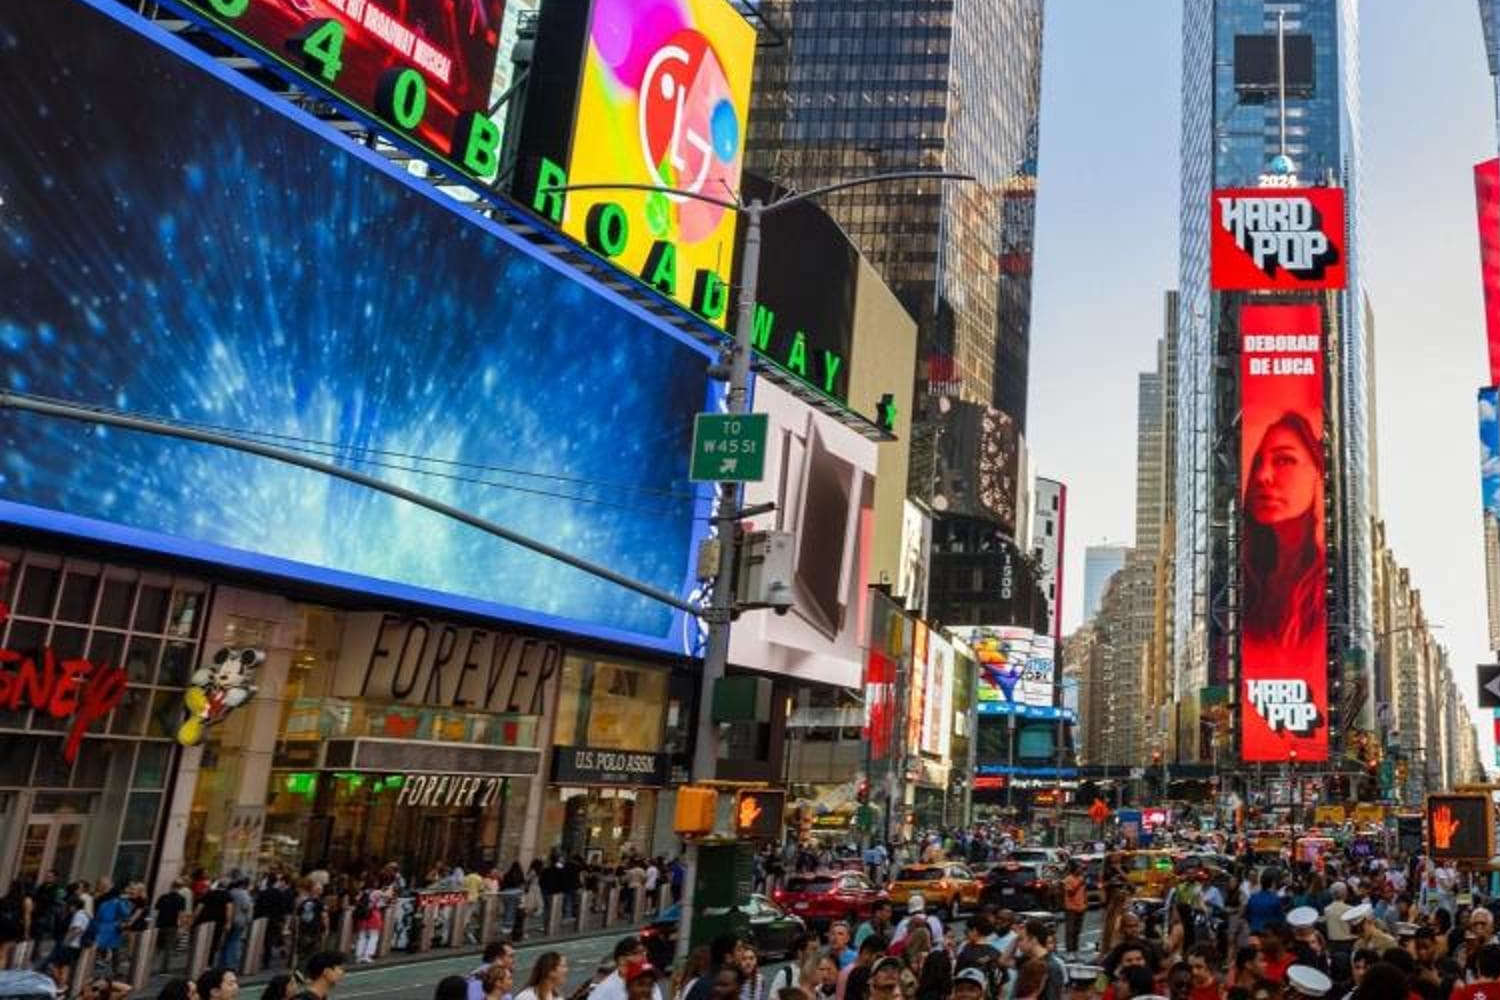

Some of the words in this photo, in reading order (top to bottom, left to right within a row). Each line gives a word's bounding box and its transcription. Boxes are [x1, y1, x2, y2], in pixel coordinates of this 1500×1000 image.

[1217, 197, 1313, 250] HARD
[463, 110, 842, 393] BROADWAY
[1248, 231, 1329, 270] POP
[1243, 334, 1320, 351] DEBORAH
[1250, 357, 1272, 375] DE
[1274, 356, 1315, 375] LUCA
[723, 420, 742, 435] TO
[361, 613, 561, 716] FOREVER
[1266, 702, 1318, 732] POP
[397, 775, 481, 808] FOREVER
